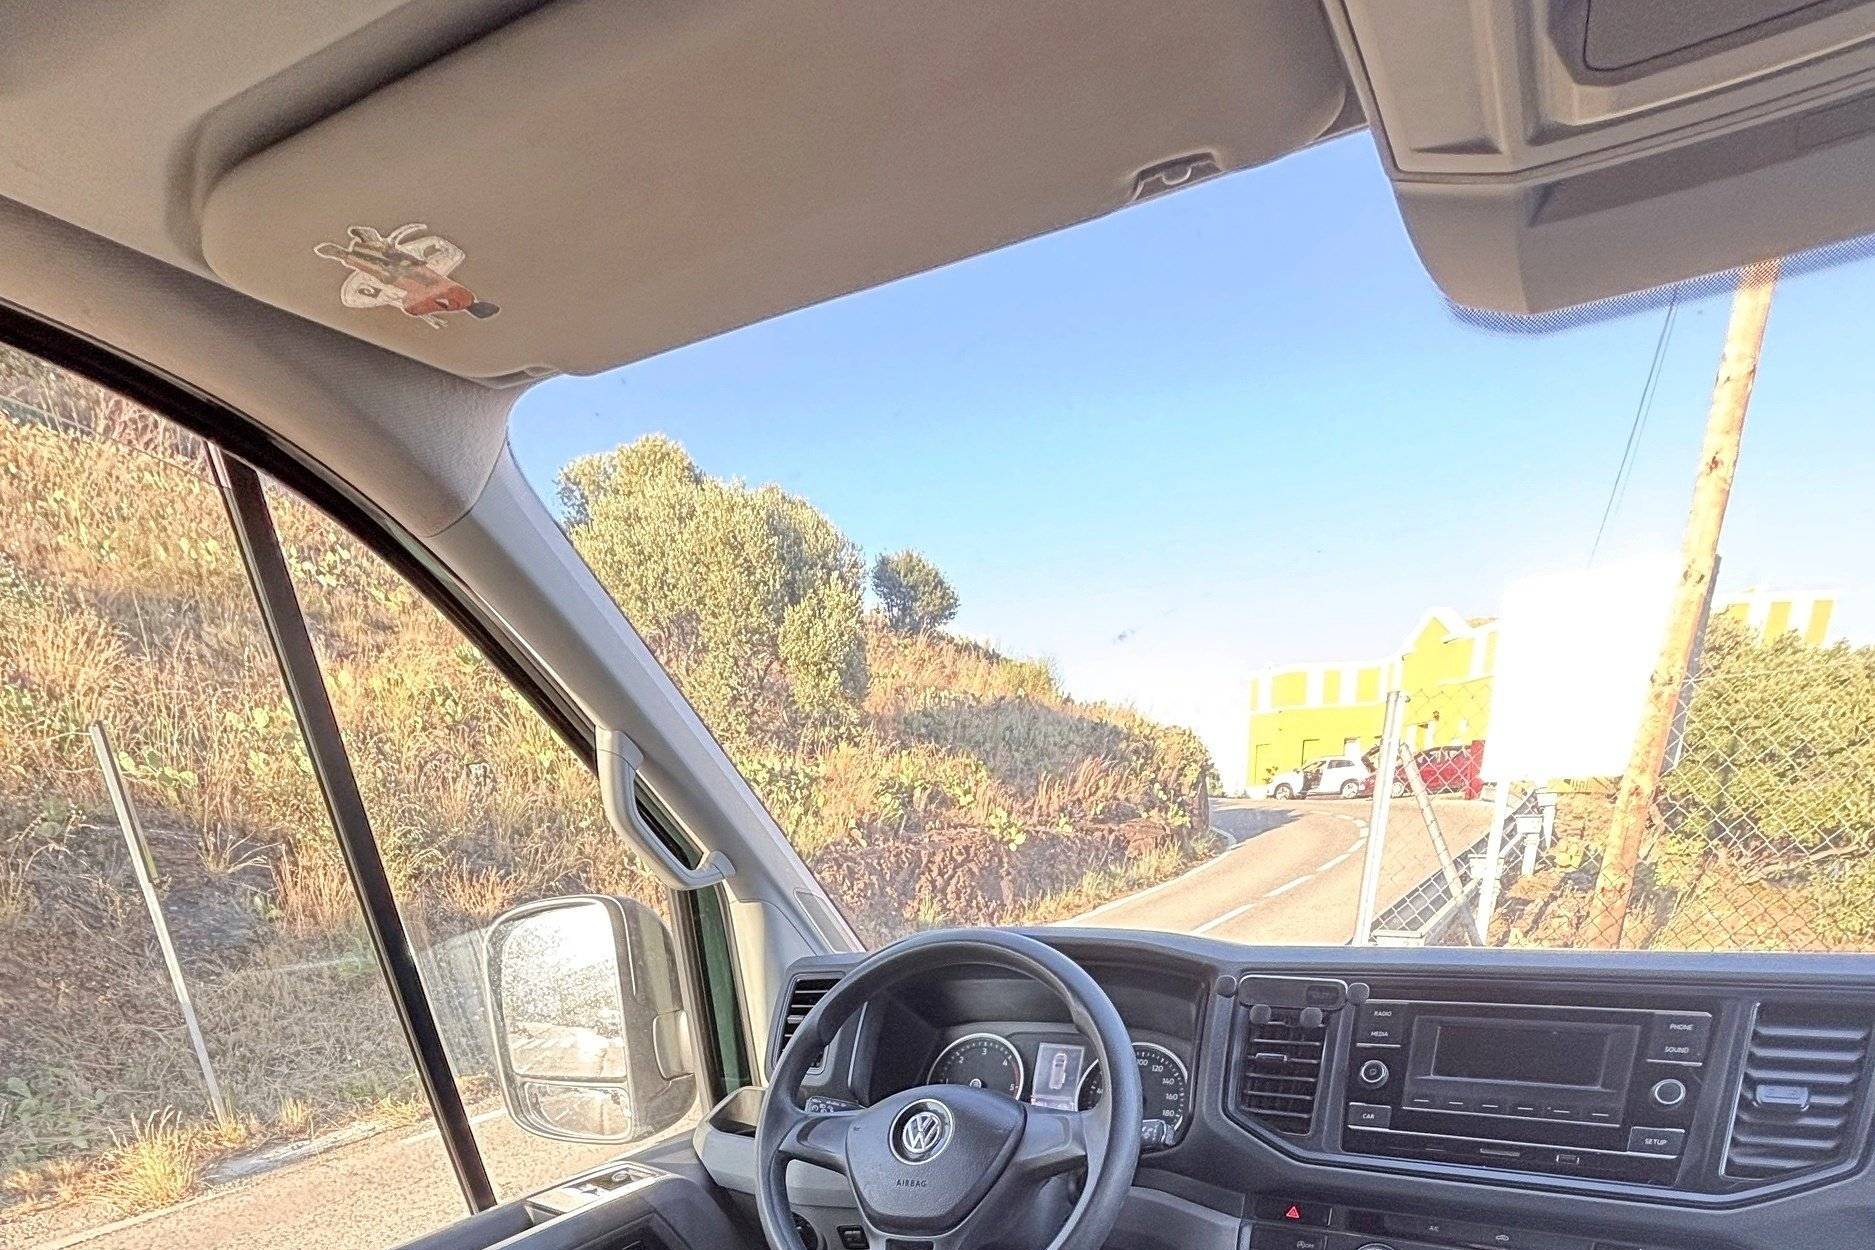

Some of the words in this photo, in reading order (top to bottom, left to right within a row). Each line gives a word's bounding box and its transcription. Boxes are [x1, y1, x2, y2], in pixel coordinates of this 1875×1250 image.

[1669, 1023, 1693, 1031] PHONE
[1664, 1046, 1690, 1054] SOUND
[1151, 1065, 1164, 1073] 120
[1165, 1093, 1179, 1101] 160
[1162, 1109, 1175, 1117] 180
[1644, 1138, 1668, 1146] SETUP
[896, 1179, 928, 1188] AIRBAG
